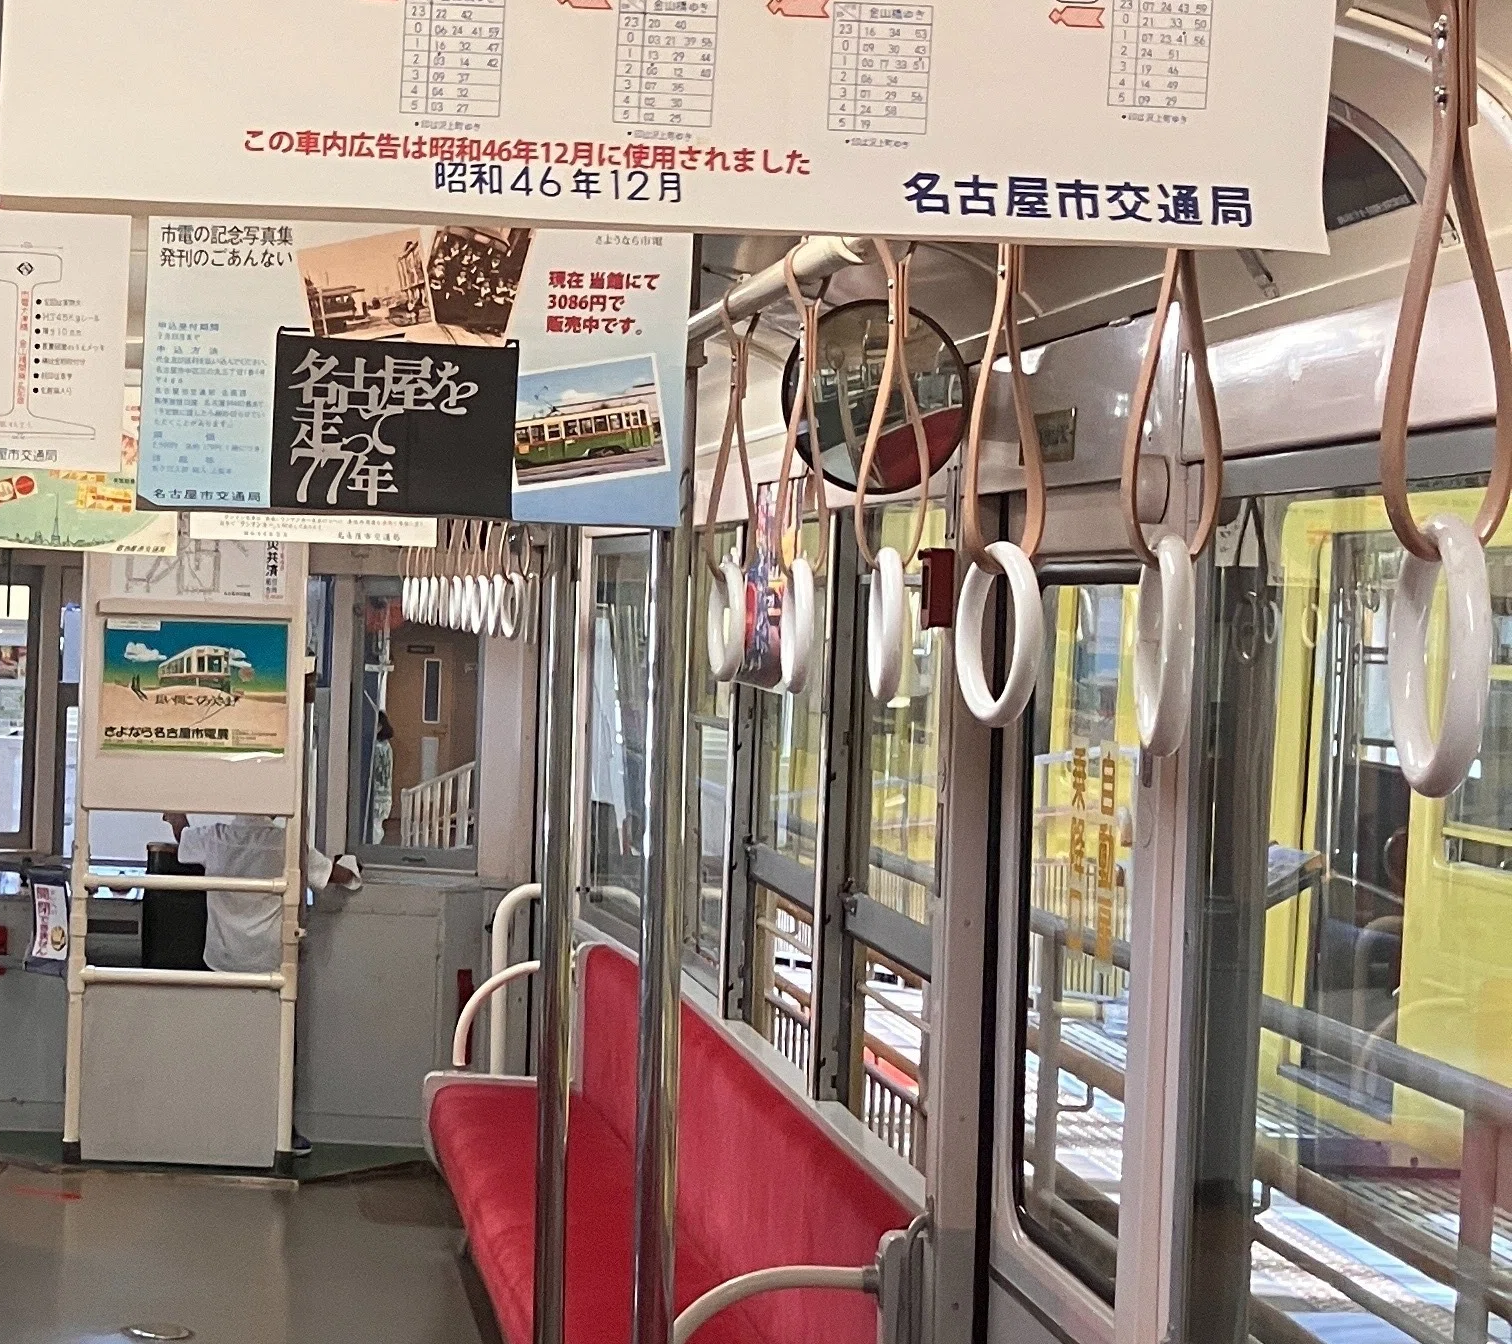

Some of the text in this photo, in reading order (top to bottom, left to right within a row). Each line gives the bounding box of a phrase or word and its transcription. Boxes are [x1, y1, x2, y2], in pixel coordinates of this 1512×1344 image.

[411, 6, 426, 17] 23
[1119, 0, 1133, 10] 23
[1122, 13, 1129, 24] 0
[414, 22, 422, 33] 0
[1123, 30, 1127, 40] 1
[1120, 46, 1128, 56] 2
[1120, 61, 1127, 71] 3
[1119, 78, 1125, 86] 4
[1118, 92, 1125, 102] 5
[243, 130, 811, 175] この車内広告は昭和46年12月に使用されました
[435, 162, 682, 203] 昭和46年12月
[903, 172, 1253, 228] 名古屋市交通局
[161, 224, 293, 247] 市電の記念写真集
[161, 248, 293, 269] 発刊のごあんない
[549, 271, 584, 289] 現在
[548, 295, 625, 312] 3086円で
[546, 316, 643, 336] 販売中です。
[289, 348, 479, 415] 名古屋を
[290, 408, 397, 457] 走って
[290, 454, 399, 507] 77年
[154, 489, 261, 503] 名古屋市交通局
